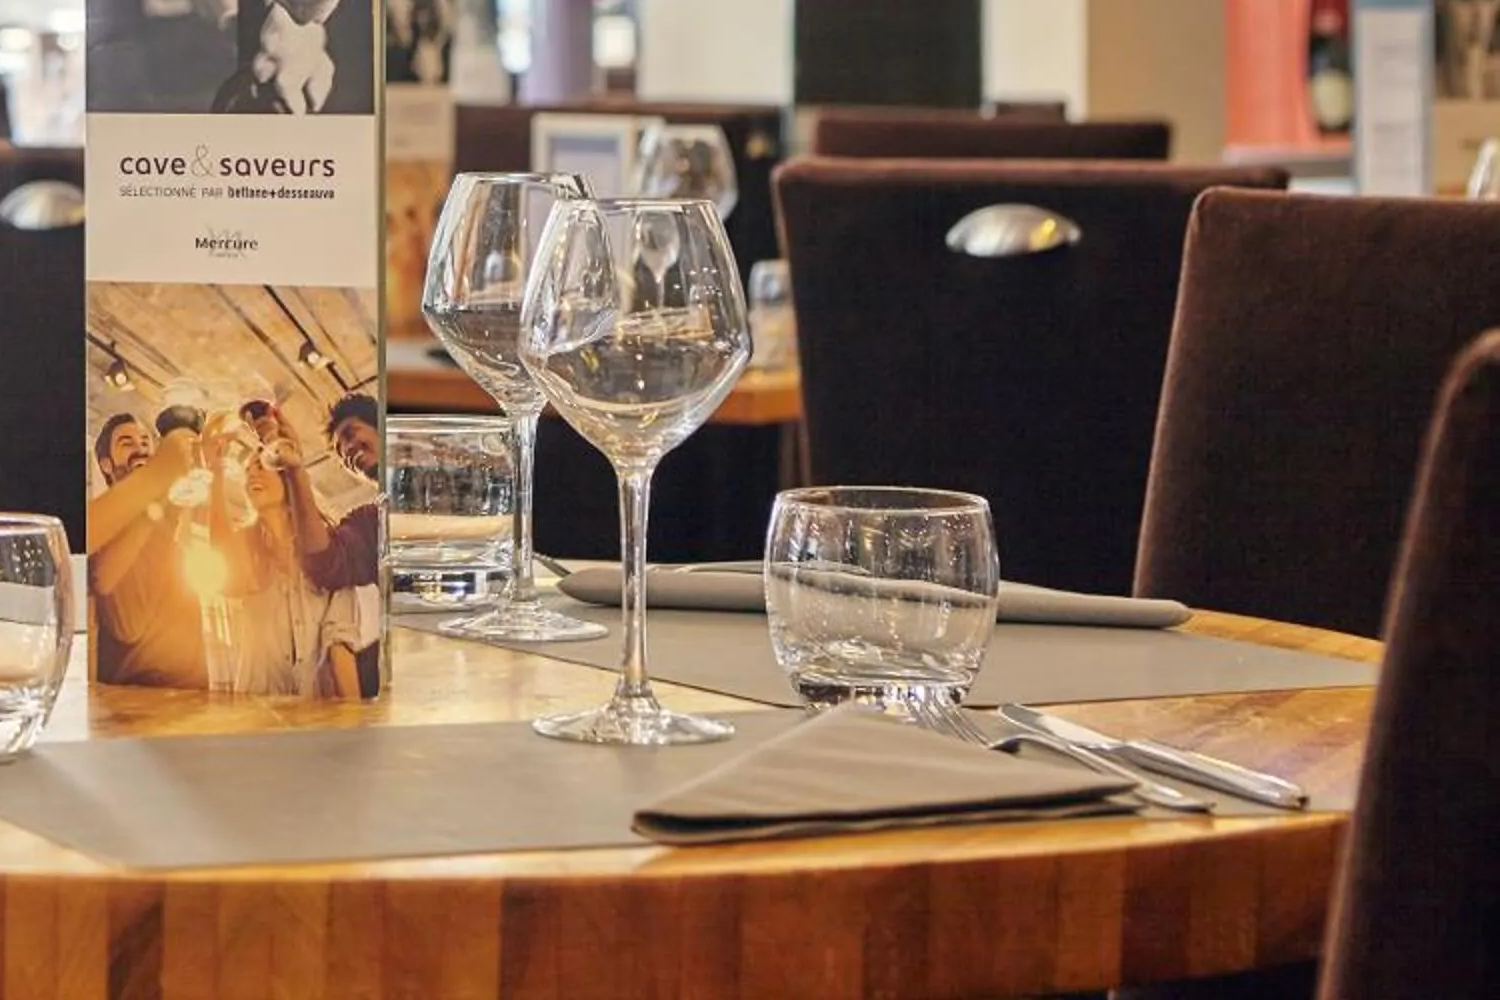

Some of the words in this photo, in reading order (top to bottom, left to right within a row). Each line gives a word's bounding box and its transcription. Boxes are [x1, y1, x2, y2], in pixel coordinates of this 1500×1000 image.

[120, 157, 186, 175] cave
[219, 157, 335, 177] saveurs
[195, 237, 259, 251] Mercure
